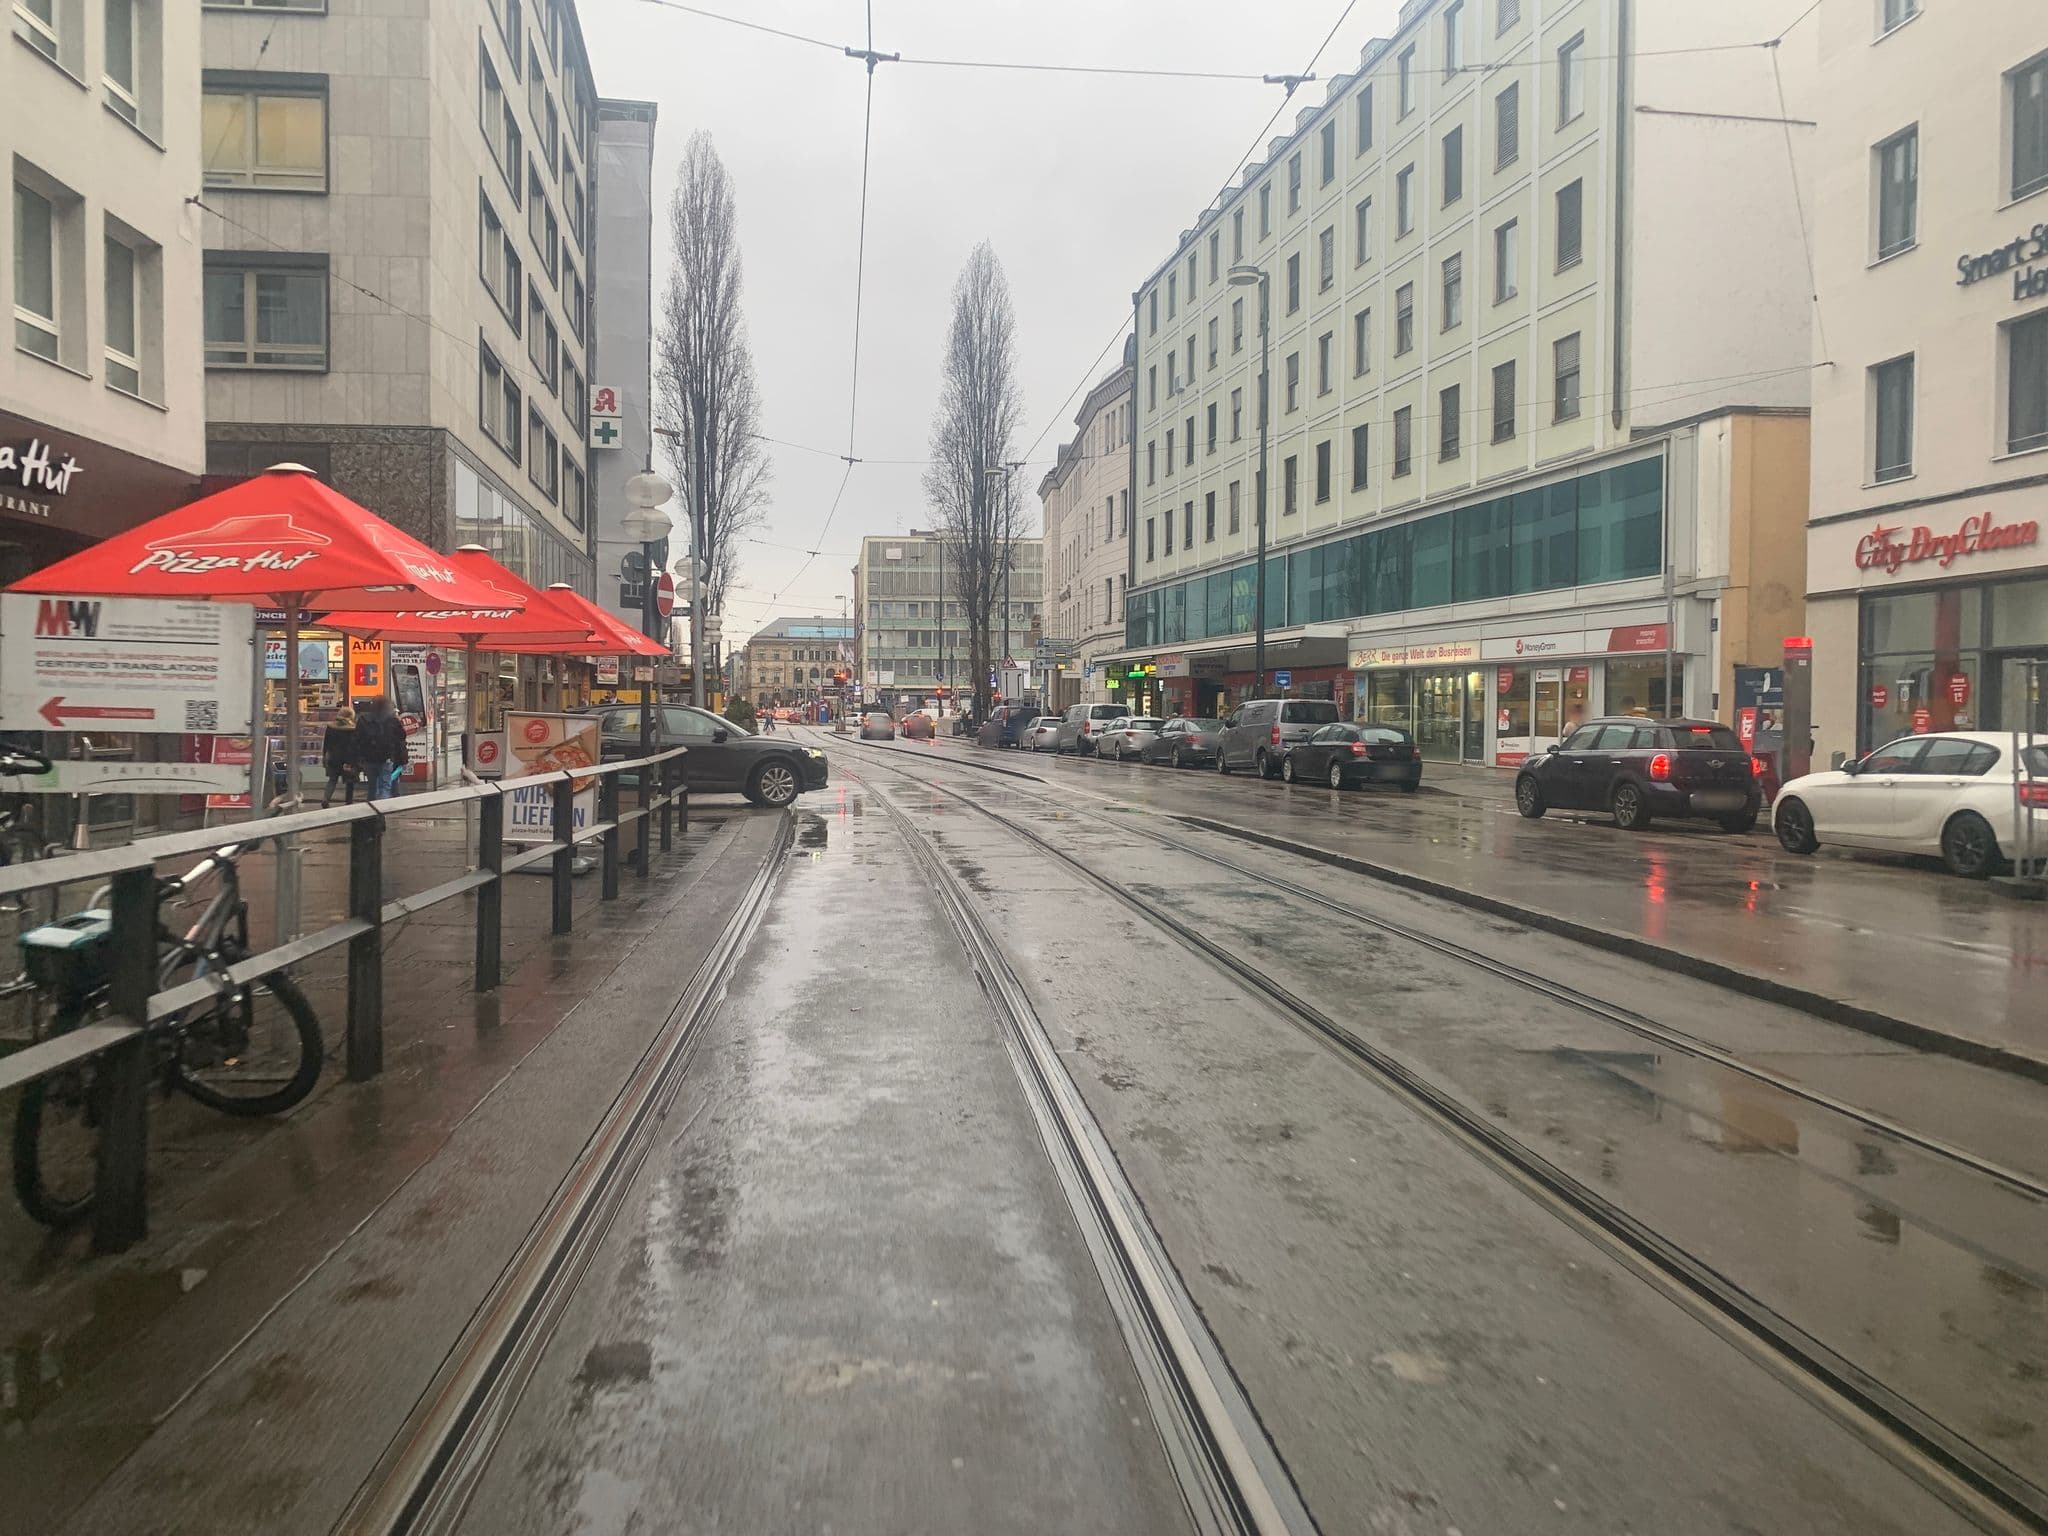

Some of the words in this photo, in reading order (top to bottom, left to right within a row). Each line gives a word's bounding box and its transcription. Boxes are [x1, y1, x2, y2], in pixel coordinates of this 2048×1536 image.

[1956, 236, 2025, 286] Smart
[2013, 266, 2048, 301] Ho
[20, 438, 84, 495] Hut
[129, 550, 240, 574] Pizza
[242, 550, 320, 572] Hut
[1855, 528, 1905, 574] City
[352, 641, 381, 650] ATM
[1381, 651, 1391, 662] Die
[1409, 649, 1425, 660] Welt
[1426, 648, 1438, 659] der
[1438, 646, 1472, 658] Busreisen
[1525, 642, 1557, 653] MoneyGram
[35, 660, 109, 670] CERTIFIED
[113, 661, 218, 673] TRANSLATIONS
[514, 785, 547, 805] WIR
[513, 805, 585, 828] LIEFN
